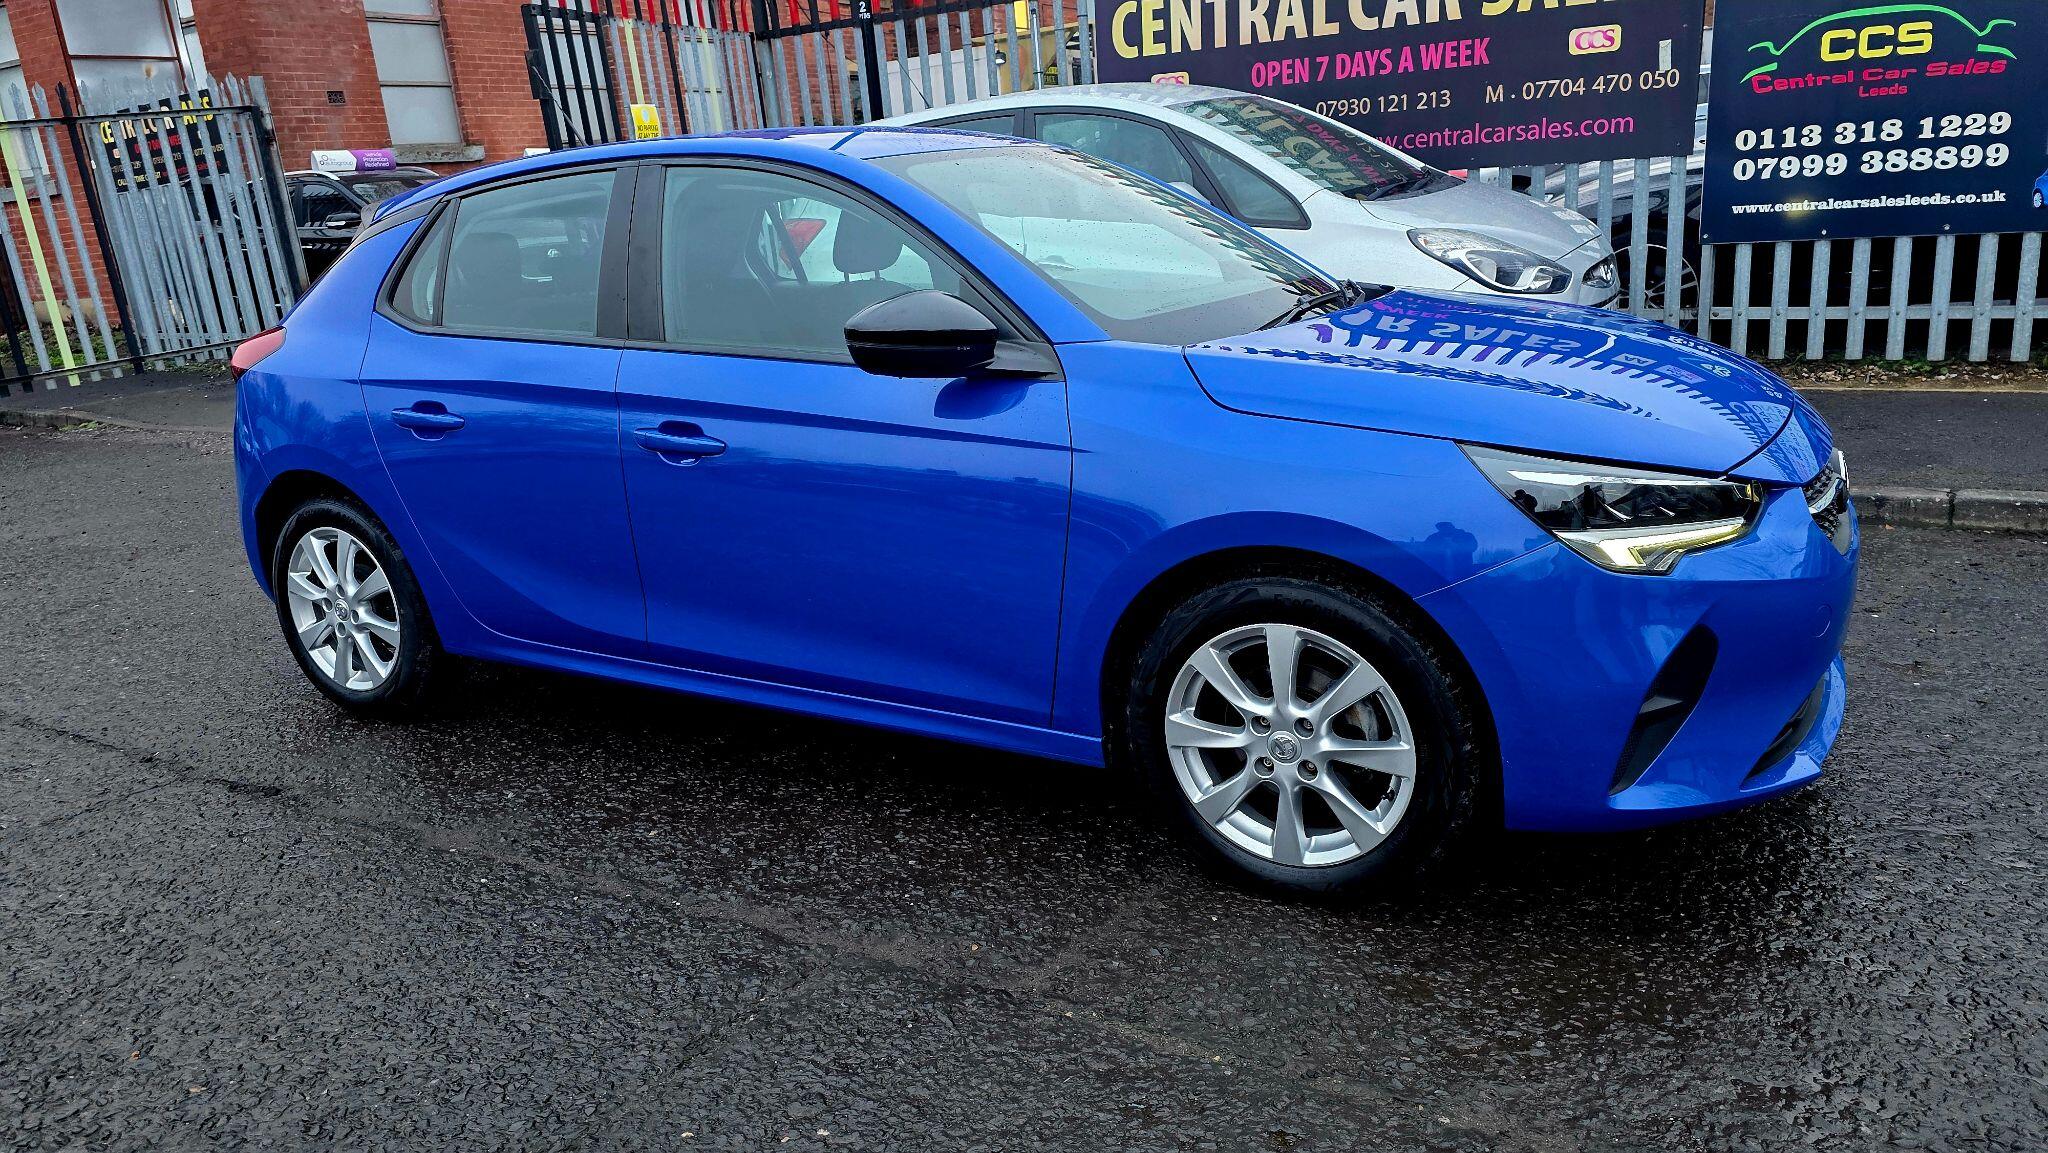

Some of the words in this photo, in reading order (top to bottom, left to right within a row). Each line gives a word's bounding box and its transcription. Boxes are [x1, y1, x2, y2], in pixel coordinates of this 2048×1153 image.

[859, 1, 867, 13] 2
[1111, 0, 1340, 59] CENTRAL
[1574, 29, 1616, 51] CCS
[1820, 21, 1933, 63] CCS
[1251, 57, 1310, 88] OPEN
[1315, 56, 1330, 82] 7
[1335, 48, 1393, 80] DAYS
[1397, 45, 1414, 74] A
[1420, 37, 1491, 71] WEEK
[1751, 70, 1854, 94] Central
[1862, 67, 1917, 82] Car
[1925, 57, 2008, 77] Sales
[1316, 97, 1371, 118] 07930
[1378, 93, 1408, 113] 121
[1416, 89, 1451, 110] 213
[1485, 84, 1504, 104] M
[1522, 77, 1586, 101] 07704
[1592, 73, 1632, 95] 470
[1639, 68, 1681, 90] 050
[1858, 83, 1908, 98] Leeds
[1375, 115, 1635, 150] w.centralcarsales.com
[1735, 124, 1822, 151] 0113
[1834, 118, 1904, 145] 318
[1919, 111, 2013, 139] 1229
[1733, 152, 1848, 181] 07999
[1860, 143, 2010, 174] 388899
[1731, 190, 2007, 214] www.centralcarsalesleeds.co.uk
